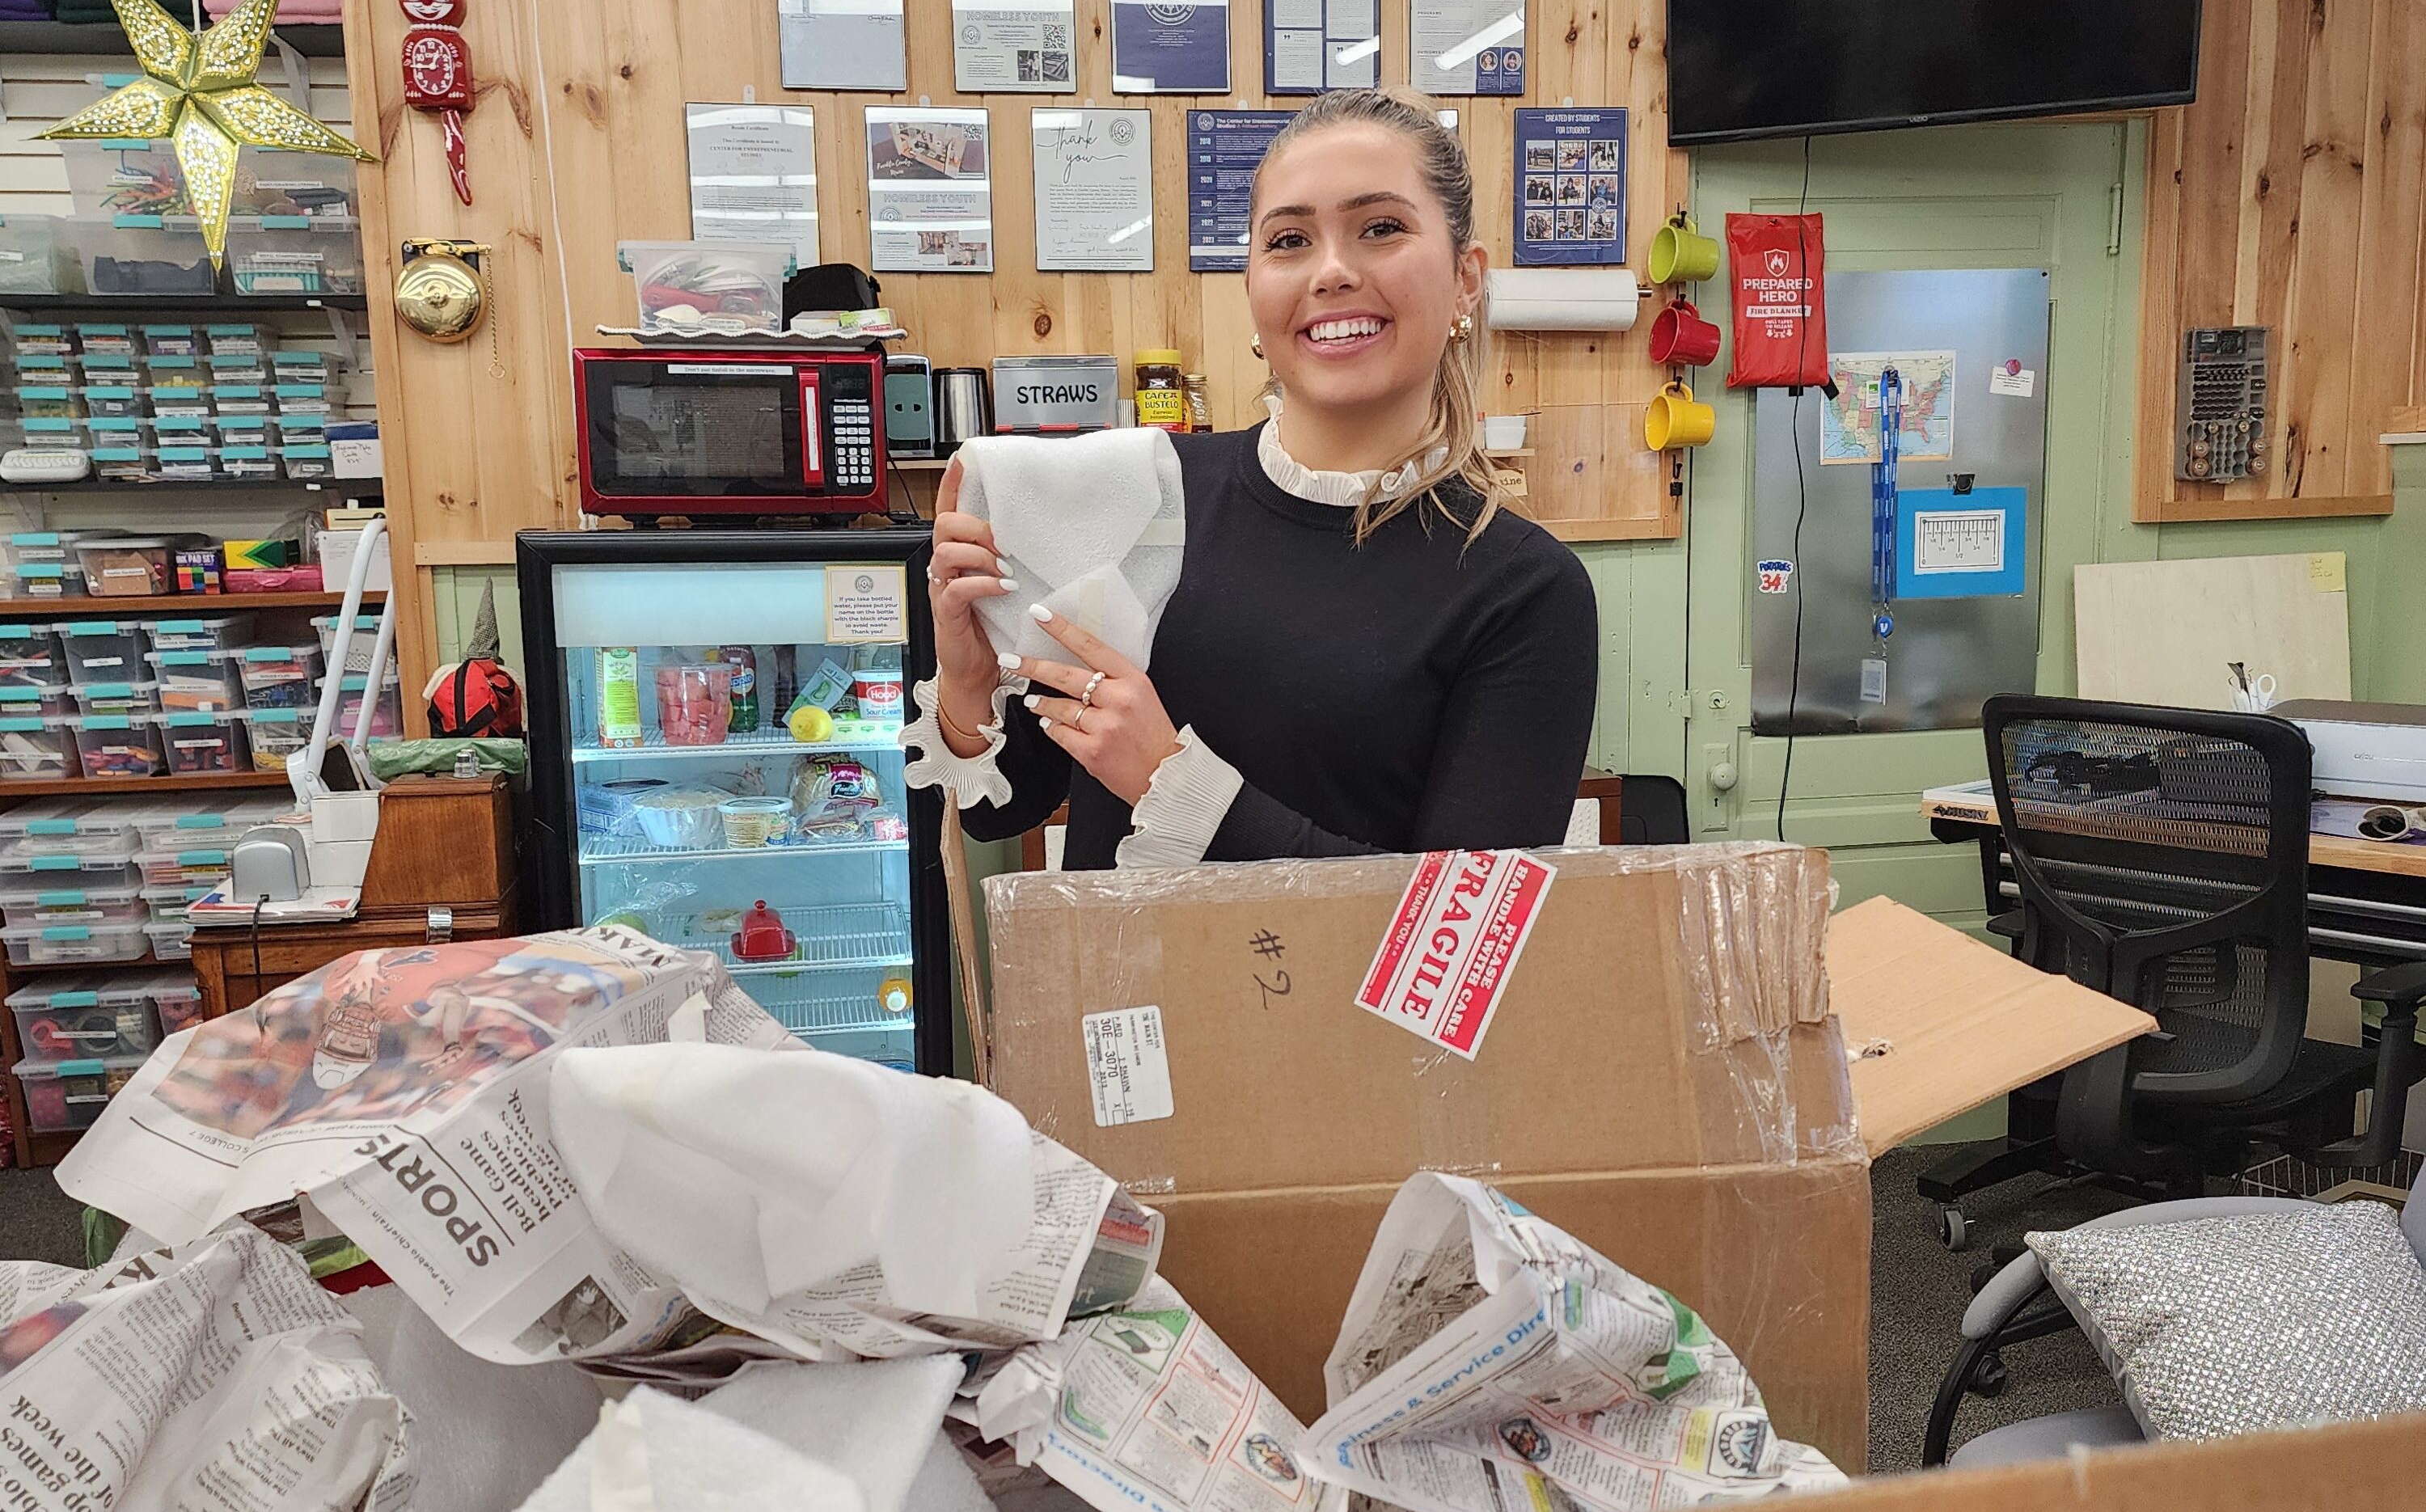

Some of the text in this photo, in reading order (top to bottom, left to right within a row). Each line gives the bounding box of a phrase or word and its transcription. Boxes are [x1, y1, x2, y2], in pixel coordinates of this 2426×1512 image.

[1555, 126, 1591, 134] FOR STUDENTS
[1575, 114, 1600, 122] STUDENTS
[1743, 278, 1813, 290] PREPARED
[1759, 291, 1798, 302] HERO
[1017, 385, 1098, 403] STRAWS
[1145, 400, 1179, 408] BUSTELO
[188, 554, 201, 564] PAD
[202, 554, 215, 564] SET
[870, 690, 897, 699] Hood
[1396, 886, 1430, 945] THANK YOU
[1401, 851, 1498, 1020] FRAGILE
[1444, 864, 1528, 1037] HANDLE WITH CARE
[1480, 923, 1518, 990] PLEASE
[505, 1088, 535, 1139] week
[460, 1138, 535, 1233] Bell Game
[481, 1131, 548, 1220] headlines
[503, 1134, 560, 1208] Pueblo's
[372, 1208, 409, 1252] Chieftain
[411, 1248, 439, 1279] Pueblo
[438, 1278, 454, 1296] The
[1407, 1341, 1503, 1411] & Service
[0, 1423, 68, 1495] games
[7, 1393, 119, 1509] of the week
